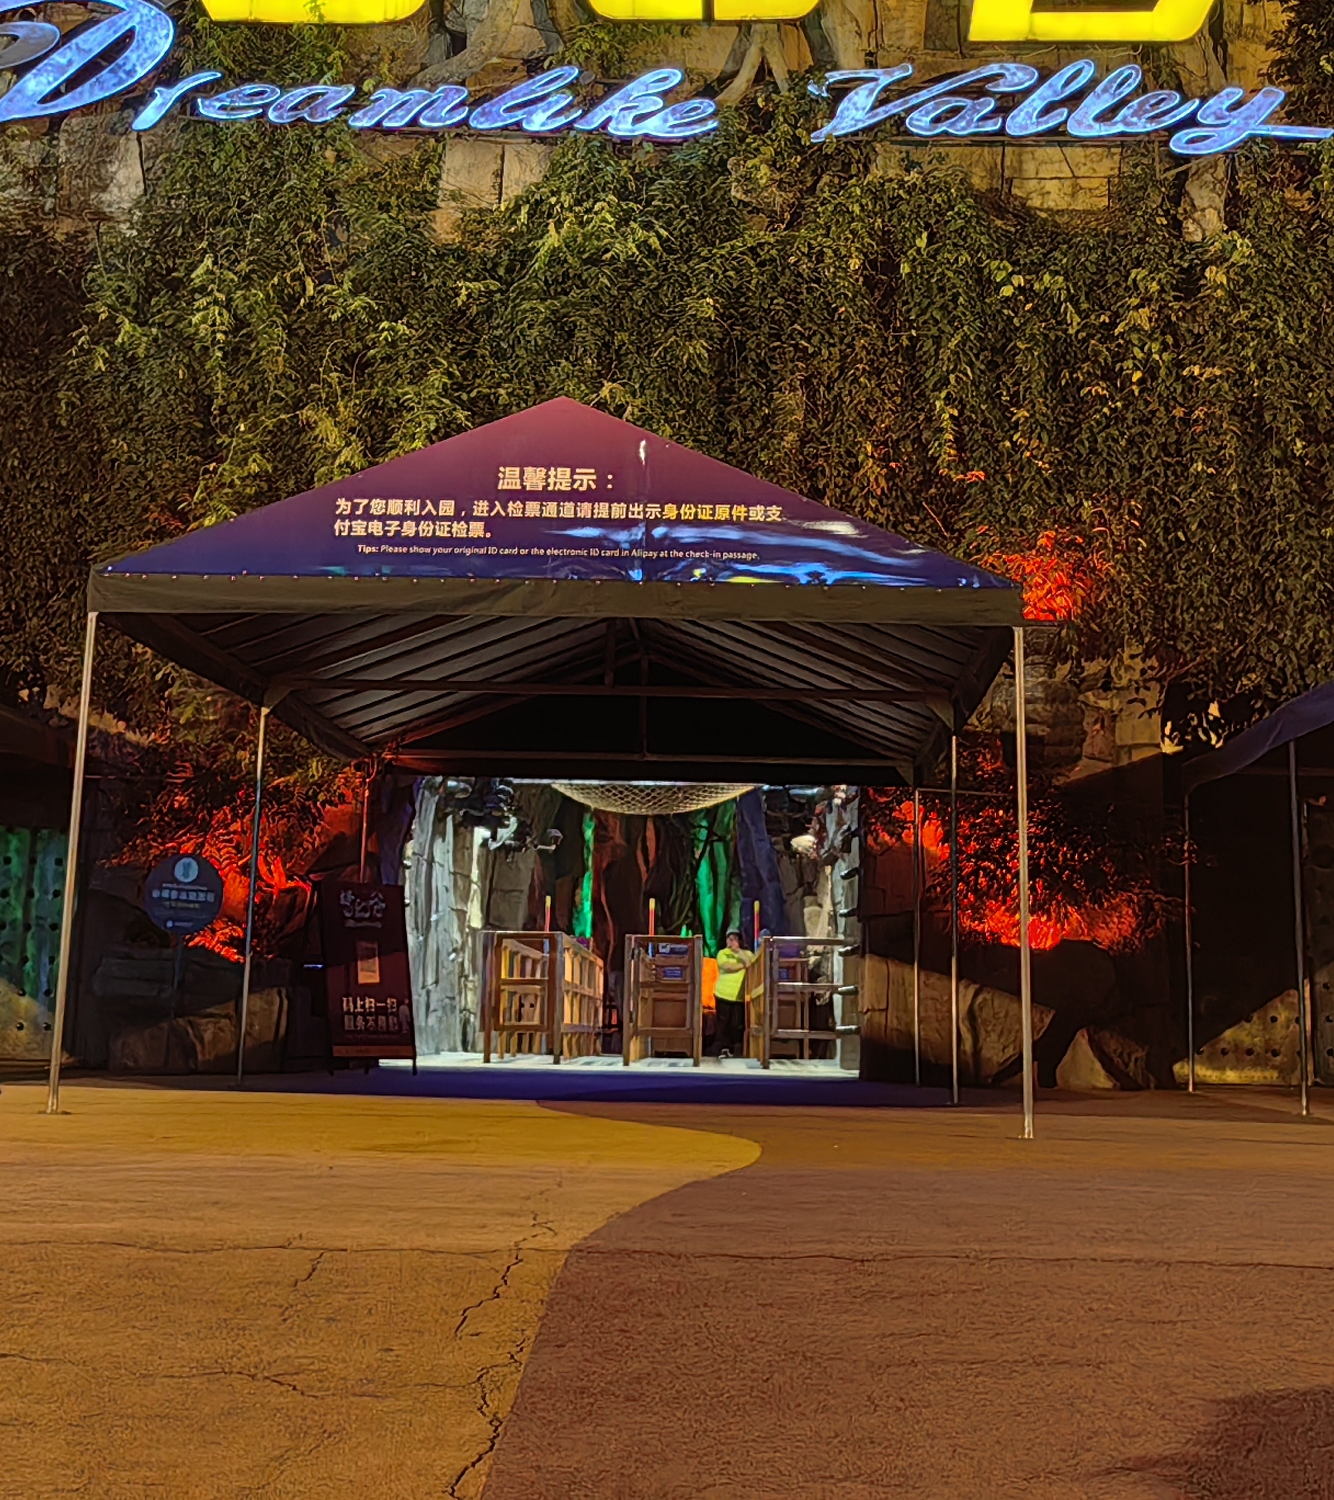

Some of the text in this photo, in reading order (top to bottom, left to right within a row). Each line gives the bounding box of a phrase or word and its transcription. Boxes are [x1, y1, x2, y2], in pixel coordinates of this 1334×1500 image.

[809, 56, 1334, 157] Valley
[335, 498, 783, 522] 为了您顺利入园，进入检票通道请提前出示身份证原件或支
[334, 519, 492, 539] 付宝电子身份证检票。
[357, 544, 379, 554] Tips:
[381, 545, 407, 554] Please
[409, 546, 431, 554] show
[433, 547, 453, 556] your
[454, 546, 487, 557] original
[488, 547, 498, 555] ID
[499, 547, 517, 555] card
[531, 548, 545, 556] the
[546, 548, 588, 556] electronic
[589, 548, 599, 556] ID
[601, 548, 619, 557] card
[621, 548, 629, 557] in
[631, 549, 658, 558] Alipay
[669, 550, 683, 558] the
[685, 550, 721, 558] check-in
